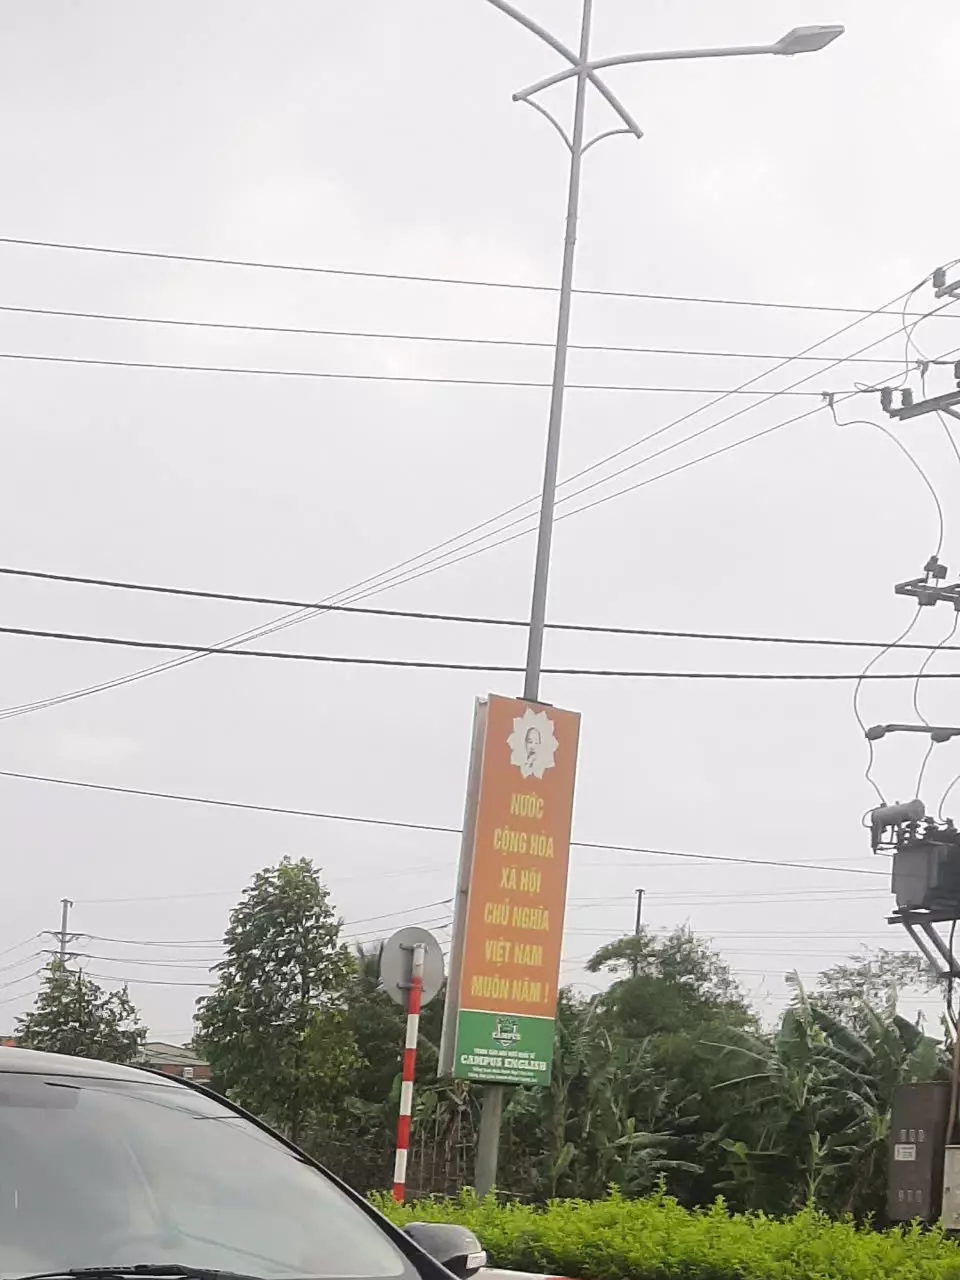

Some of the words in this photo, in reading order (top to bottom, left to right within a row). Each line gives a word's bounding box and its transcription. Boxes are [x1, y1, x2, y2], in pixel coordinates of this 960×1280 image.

[493, 825, 527, 856] CỘNG
[485, 937, 511, 967] VIỆT
[514, 943, 542, 966] NAM
[471, 973, 509, 1000] MUÔN
[460, 1055, 502, 1067] CAMPUS
[504, 1059, 547, 1071] ENGLISH
